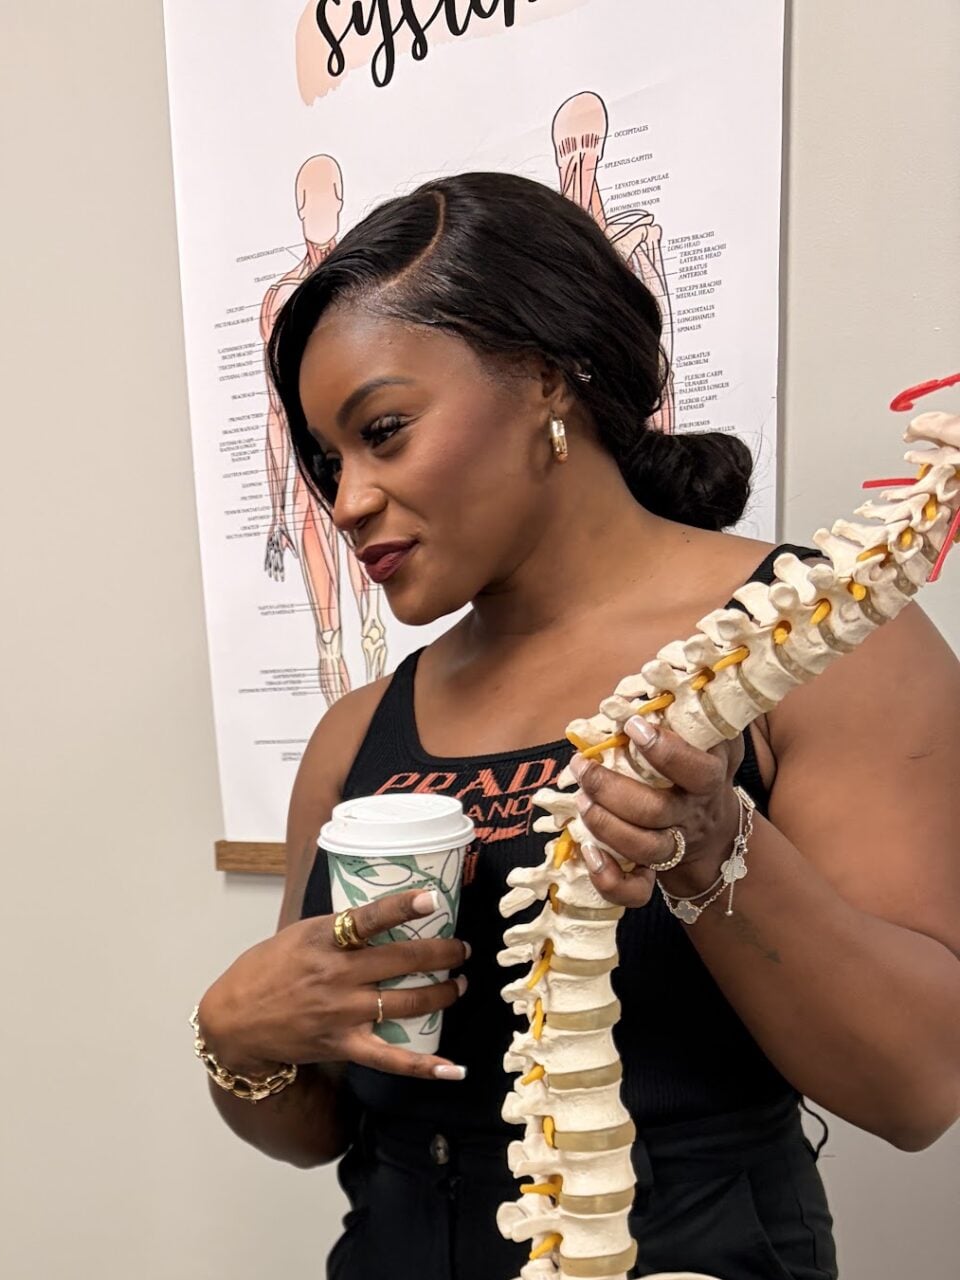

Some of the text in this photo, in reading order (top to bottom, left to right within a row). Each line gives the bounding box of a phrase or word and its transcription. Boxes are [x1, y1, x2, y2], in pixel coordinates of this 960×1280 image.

[614, 125, 649, 138] OCCIPITALIS
[604, 153, 653, 169] SPLENIUS CAPITIS
[614, 173, 669, 190] LEVATOR SCAPULAE
[610, 185, 661, 201] RHOMBOID MINOR
[641, 198, 660, 208] MAJOR
[667, 236, 691, 245] TRICEPS
[667, 240, 701, 252] LONG HEAD
[679, 251, 722, 264] LATERAL HEAD
[680, 248, 703, 257] TRICEPS
[698, 288, 715, 296] HEAD
[374, 758, 559, 799] PRAD
[467, 794, 534, 821] ANO
